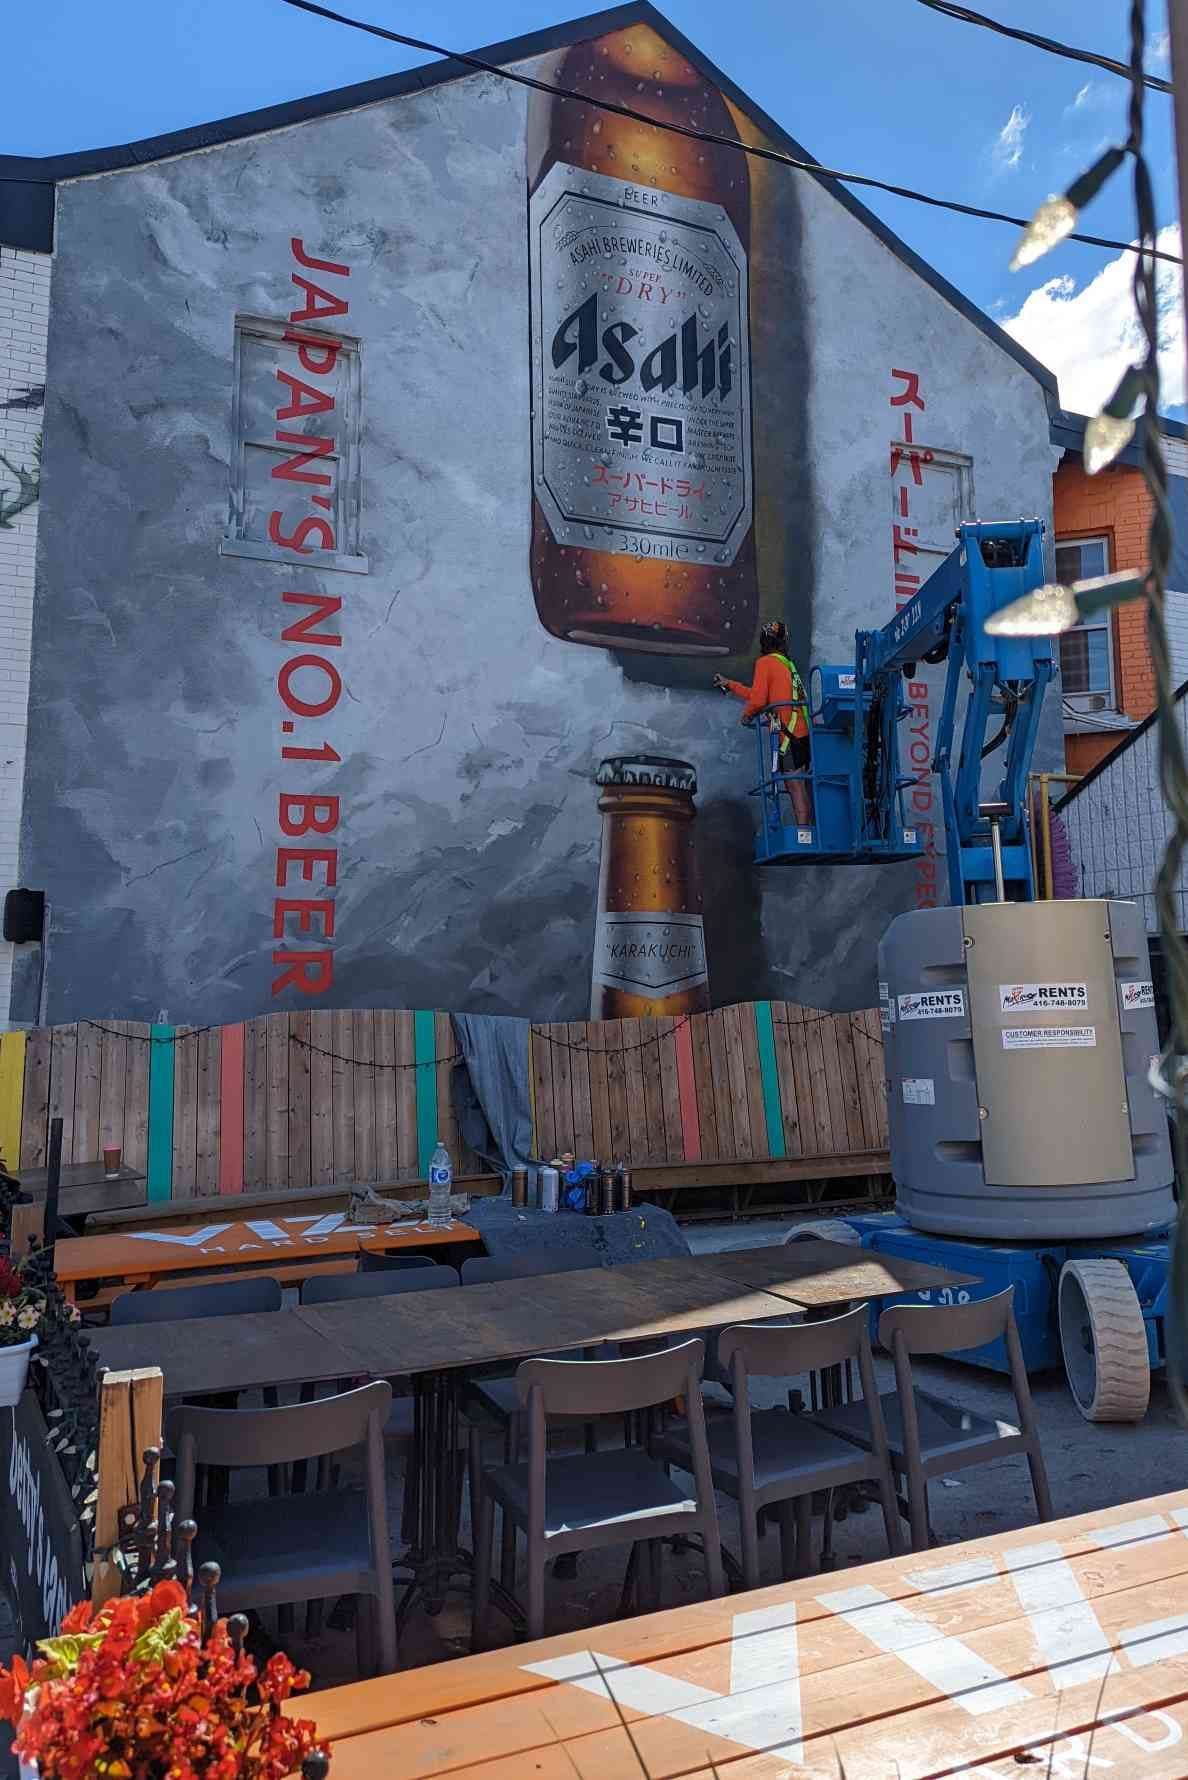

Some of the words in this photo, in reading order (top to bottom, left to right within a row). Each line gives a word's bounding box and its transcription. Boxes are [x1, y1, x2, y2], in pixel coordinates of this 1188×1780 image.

[624, 188, 659, 207] BEER
[569, 237, 601, 266] ASAHI
[602, 238, 671, 265] BREWERIES
[672, 256, 713, 296] LIMITED
[629, 268, 662, 282] SUPER
[551, 292, 733, 402] Asahi
[267, 238, 350, 554] JAPAN'S
[606, 405, 684, 452] 辛口
[591, 464, 705, 501] スーパードライ
[277, 591, 342, 762] NO.1
[908, 681, 933, 812] BEYOND
[271, 793, 340, 997] BEER
[920, 993, 961, 1006] RENTS
[1038, 986, 1086, 998] RENTS
[1005, 1029, 1043, 1039] CUSTOMER
[200, 1236, 330, 1254] HARD
